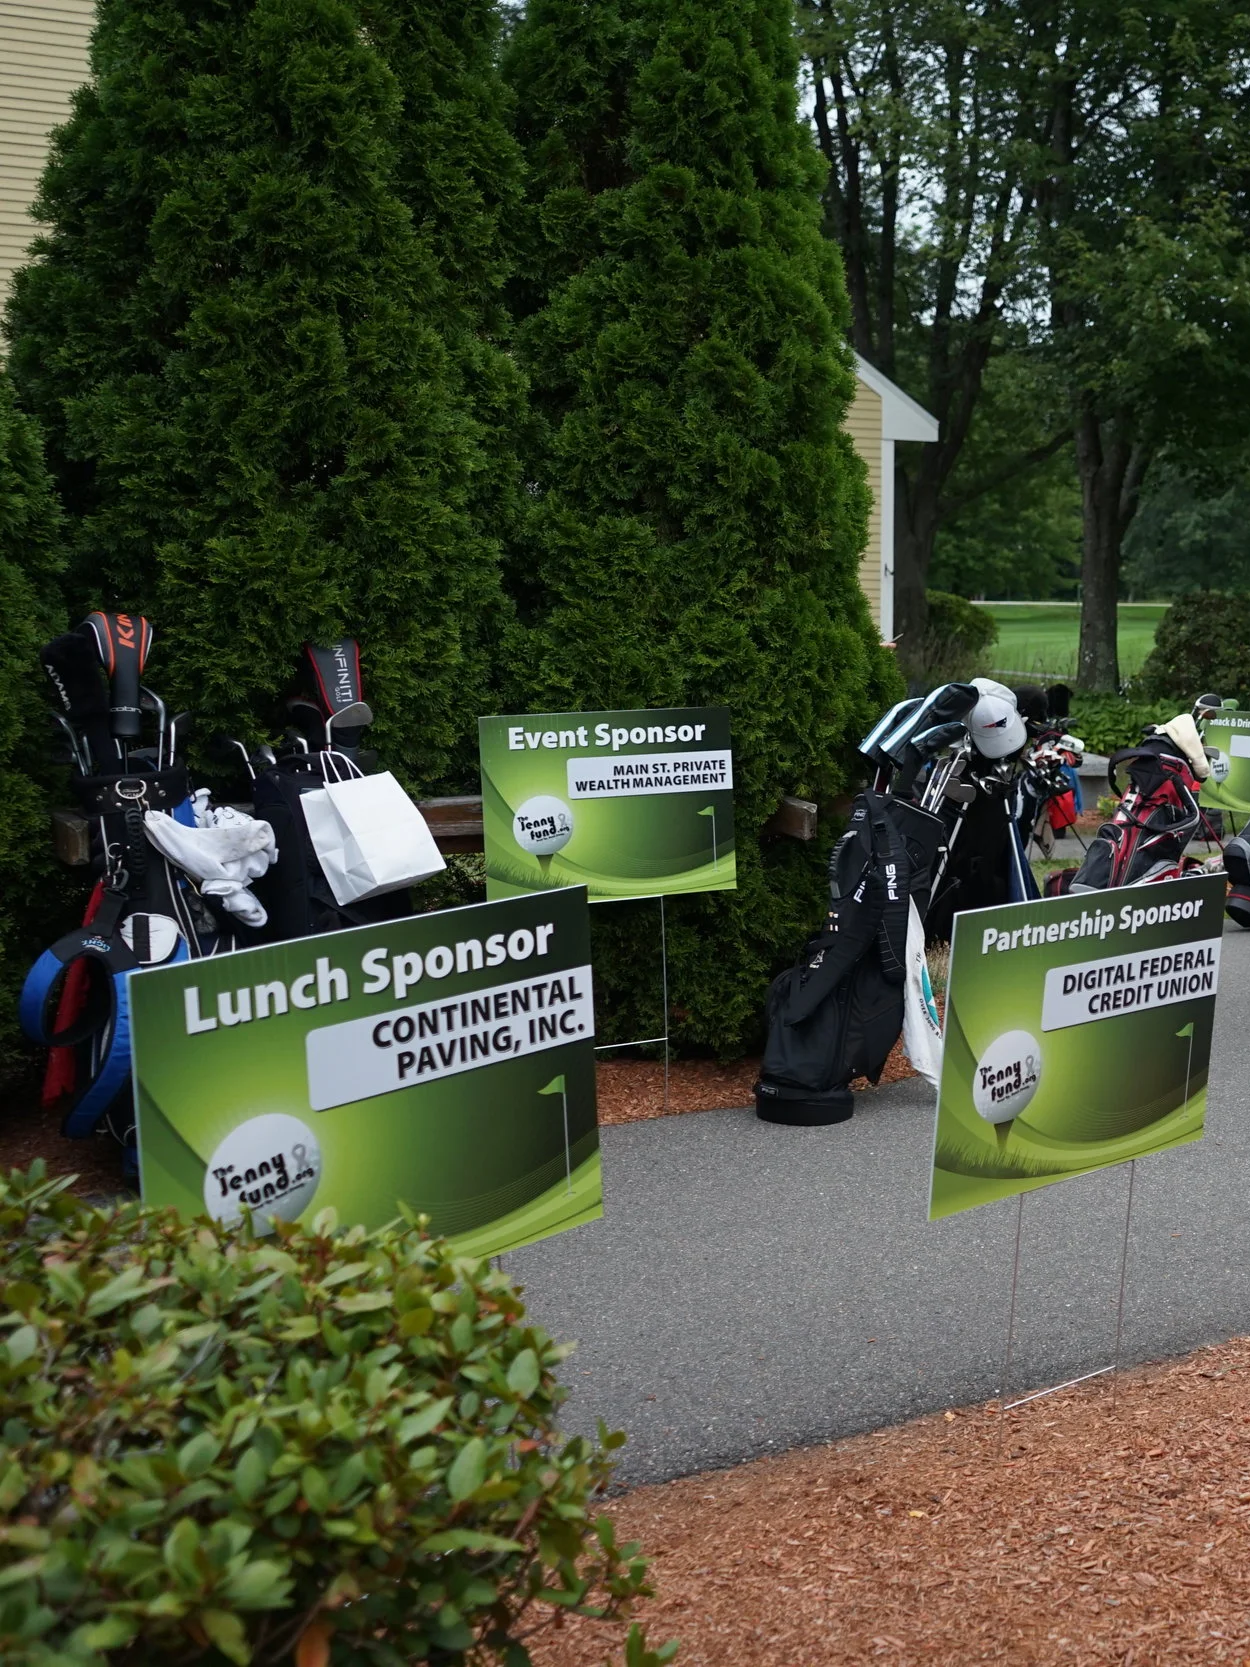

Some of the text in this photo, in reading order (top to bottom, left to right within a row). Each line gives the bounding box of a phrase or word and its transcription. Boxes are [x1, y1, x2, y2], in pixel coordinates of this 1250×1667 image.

[45, 664, 71, 711] ADAMS
[508, 723, 706, 751] Event Sponsor
[576, 772, 726, 792] WEALTH MANAGEMENT
[613, 759, 726, 776] MAIN ST. PRIVATE
[521, 816, 555, 831] Jenny
[885, 863, 899, 900] PING
[981, 898, 1203, 954] Partnership Sponsor
[183, 922, 554, 1035] Lunch Sponsor
[1062, 947, 1215, 996] DIGITAL FEDERAL
[1088, 971, 1214, 1014] CREDIT UNION
[372, 975, 583, 1049] CONTINENTAL
[396, 1008, 585, 1080] PAVING, INC.
[982, 1061, 1021, 1090] Jenny
[220, 1153, 285, 1197] Jenny
